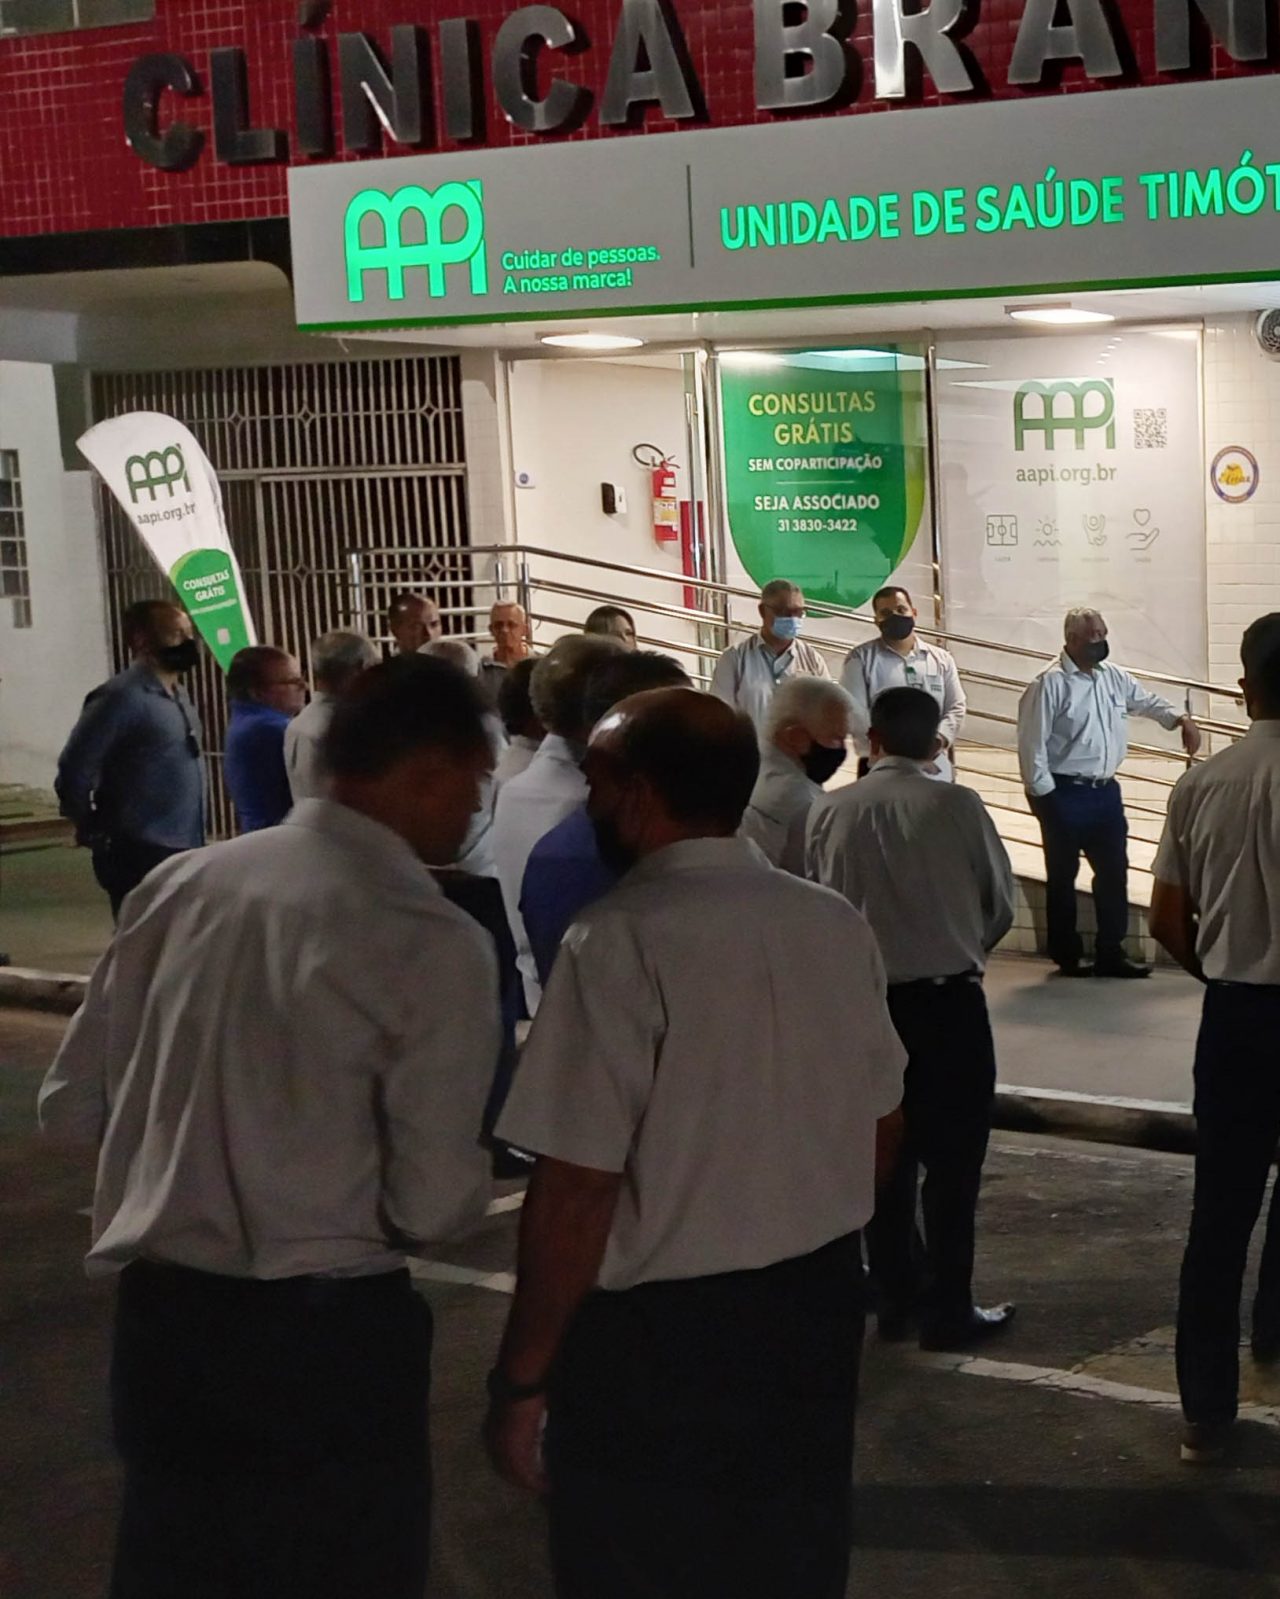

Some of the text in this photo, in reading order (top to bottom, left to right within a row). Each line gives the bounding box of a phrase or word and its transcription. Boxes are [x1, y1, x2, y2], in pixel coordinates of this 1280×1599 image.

[124, 0, 698, 171] CLÍNICA
[720, 193, 899, 250] UNIDADE
[912, 188, 965, 237] DE
[975, 166, 1125, 231] SAÚDE
[502, 246, 661, 270] Cuidar de pessoas.
[503, 268, 632, 294] A nossa marca!
[748, 391, 876, 416] CONSULTAS
[774, 417, 853, 445] GRÁTIS
[748, 453, 883, 473] SEM COPARTICIPAÇÃO
[1016, 463, 1118, 487] aapi.org.br
[754, 493, 880, 511] SEJA ASSOCIADO
[778, 518, 858, 532] 31 3830-3422
[183, 569, 230, 591] CONSULTAS
[195, 584, 226, 602] GRÁTIS
